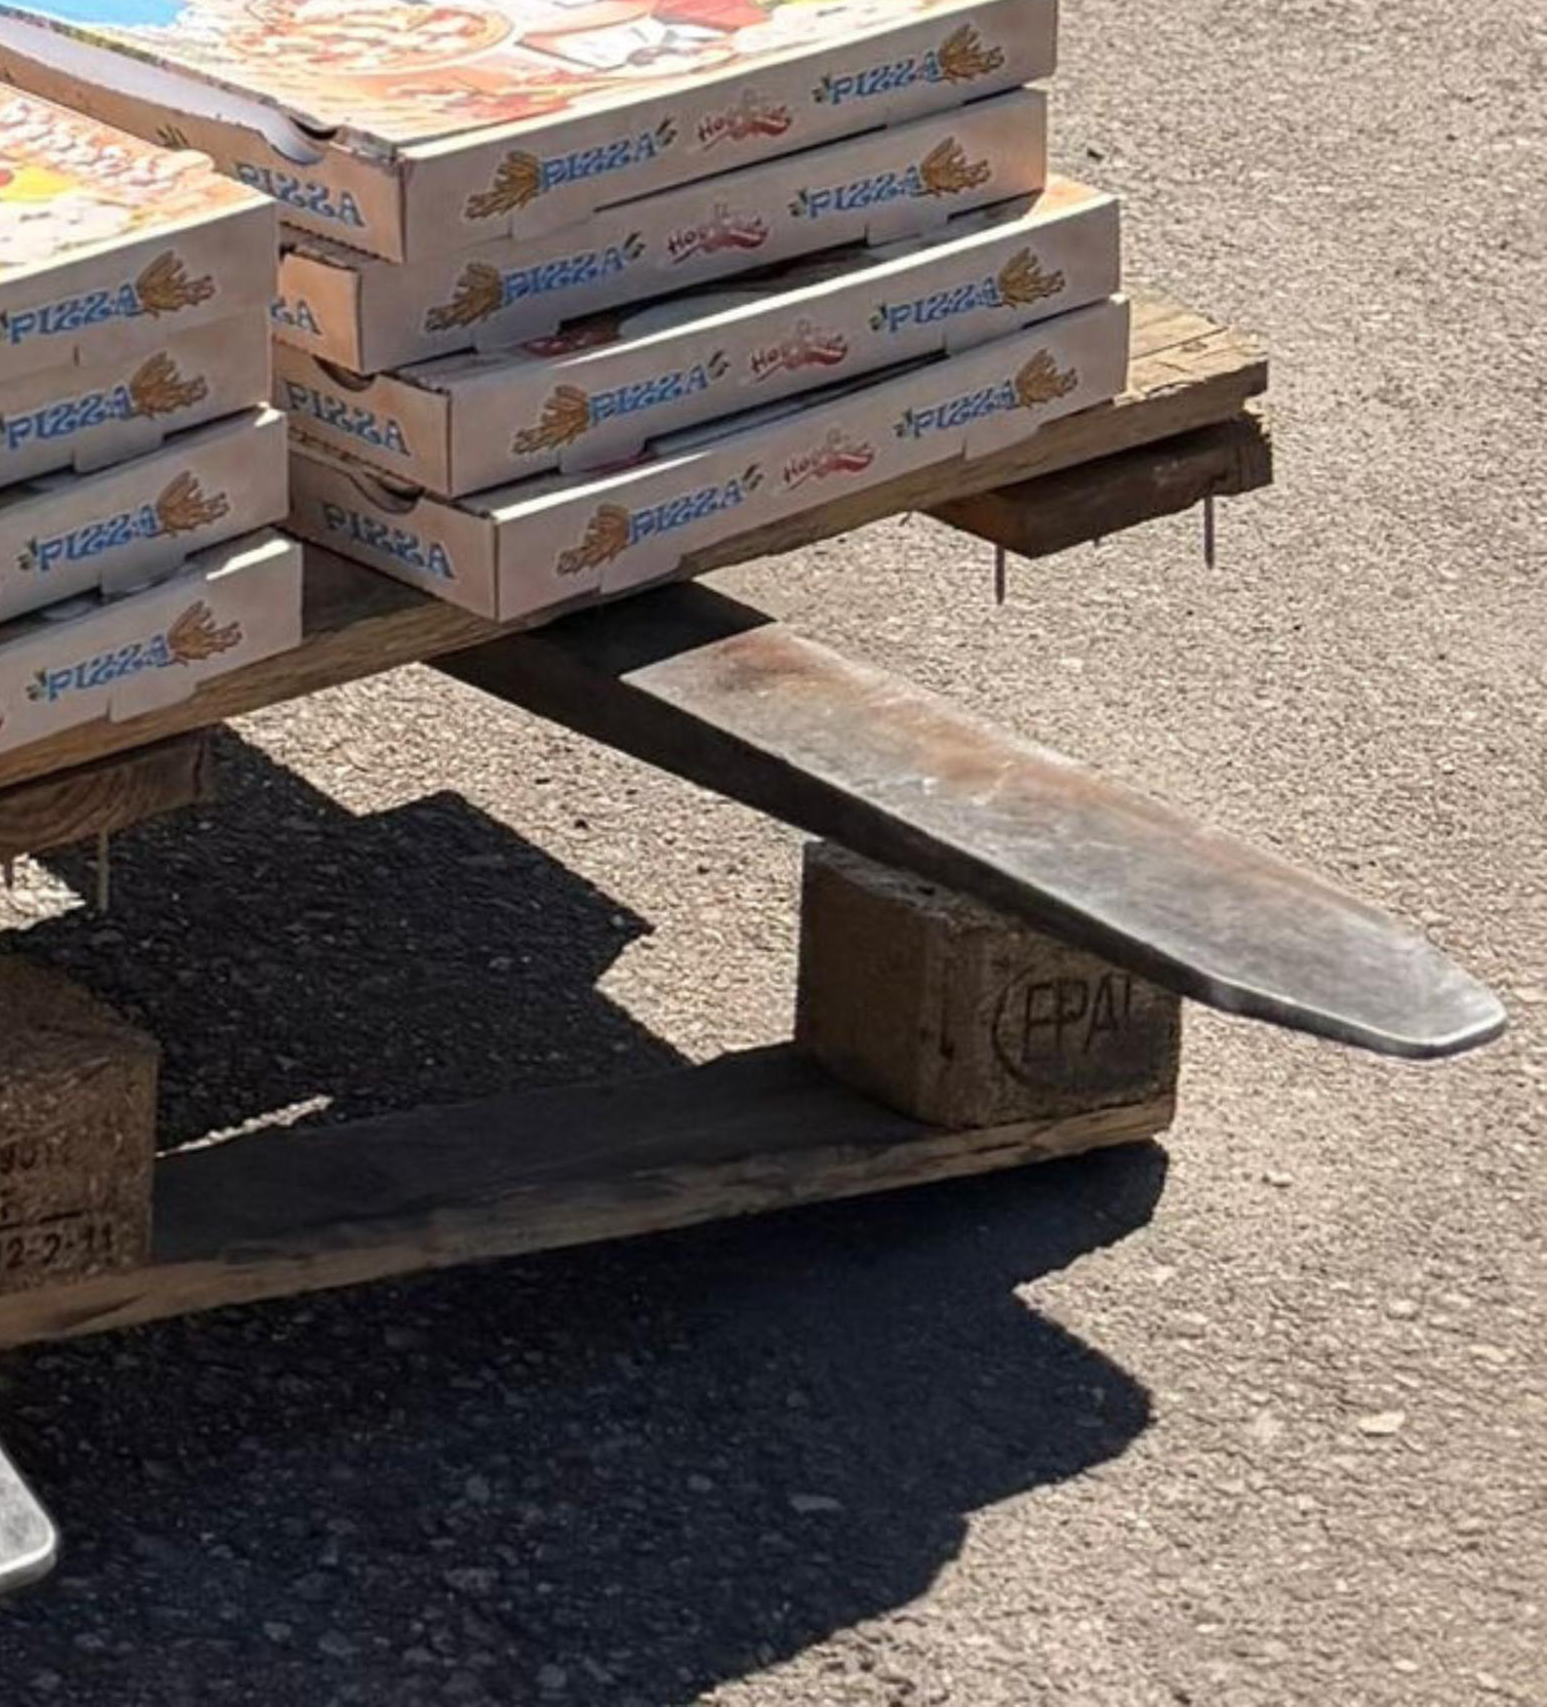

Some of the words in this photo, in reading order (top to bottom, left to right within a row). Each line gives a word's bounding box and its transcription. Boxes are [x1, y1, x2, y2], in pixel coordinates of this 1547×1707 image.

[831, 51, 941, 104] PIZZA
[540, 133, 658, 189] PIZZA
[811, 163, 922, 218] PIZZA
[502, 249, 626, 308] PIZZA
[888, 280, 999, 333] PIZZA
[8, 284, 138, 345] PIZZA
[6, 388, 134, 451] PIZZA
[287, 383, 411, 456] PIZZA
[588, 364, 710, 427] PIZZA
[914, 380, 1018, 438] PIZZA
[38, 505, 159, 571] PIZZA
[324, 501, 455, 580] PIZZA
[630, 481, 747, 544] PIZZA
[47, 634, 171, 702] PIZZA
